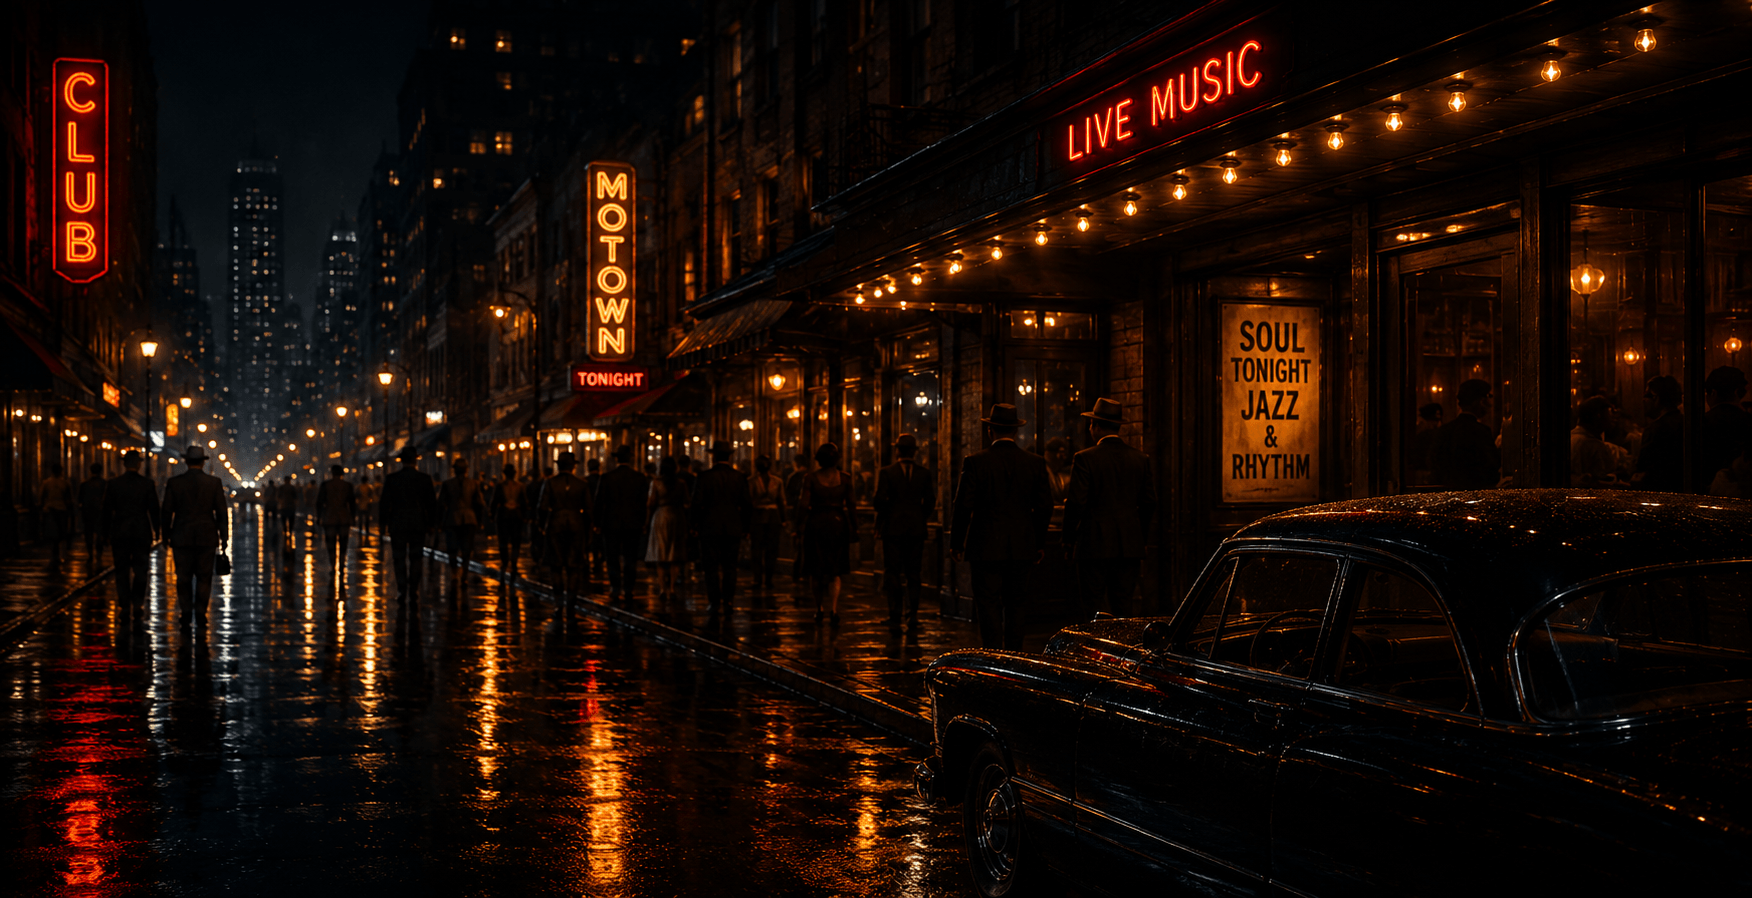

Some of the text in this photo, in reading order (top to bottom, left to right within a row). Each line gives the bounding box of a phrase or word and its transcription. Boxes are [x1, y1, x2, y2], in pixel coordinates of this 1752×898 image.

[1067, 40, 1263, 162] LIVE MUSIC
[64, 71, 97, 263] CLUB
[595, 171, 629, 355] MOTOWN
[1240, 320, 1305, 353] SOUL
[577, 371, 644, 387] TONIGHT
[1231, 357, 1311, 383] TONIGHT
[1241, 390, 1299, 420] JAZZ
[1264, 425, 1278, 448] &
[1232, 454, 1310, 480] RHYTHM
